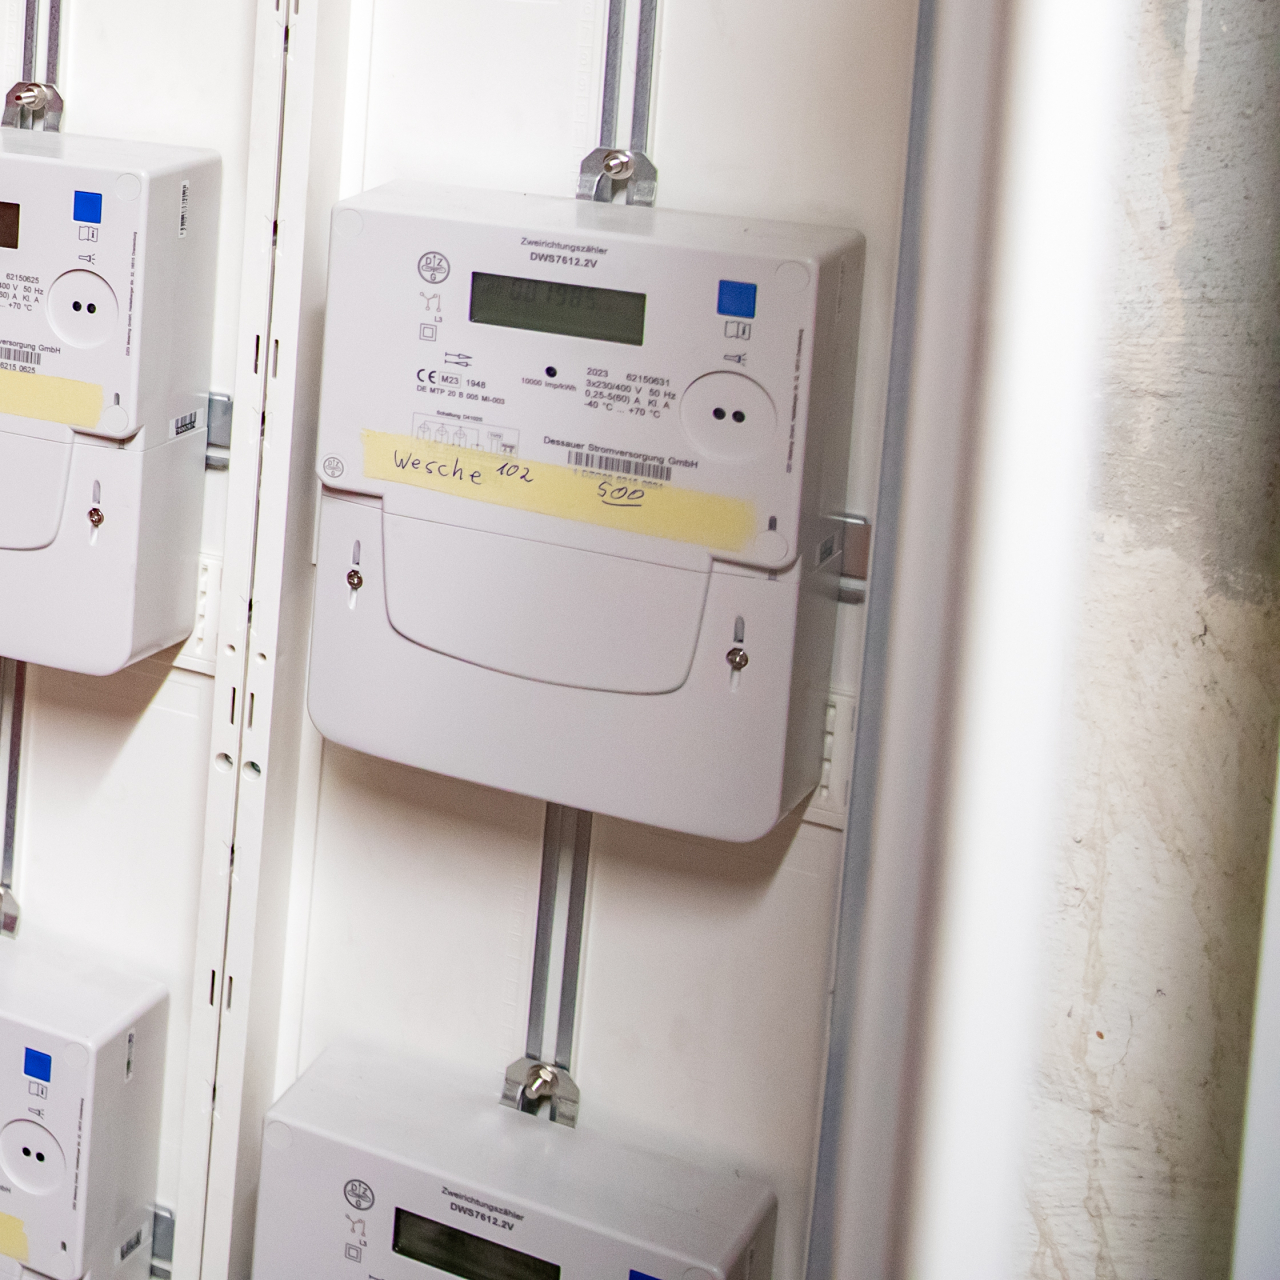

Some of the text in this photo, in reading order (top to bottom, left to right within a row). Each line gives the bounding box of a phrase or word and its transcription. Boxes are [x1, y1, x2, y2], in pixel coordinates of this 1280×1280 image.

[520, 237, 608, 256] Zweirichtungszähler
[530, 251, 598, 269] DWS7612.2V
[5, 273, 39, 284] 62150625
[23, 285, 32, 293] 50
[34, 287, 44, 295] Hz
[8, 302, 21, 310] +70
[38, 344, 61, 354] GmbH
[0, 361, 17, 371] 6215
[441, 375, 459, 385] M23
[466, 379, 486, 389] 1948
[522, 377, 542, 386] 10000
[586, 367, 670, 387] 2023 62150631
[416, 384, 427, 392] DE
[429, 386, 445, 395] MTP
[447, 389, 456, 397] 20
[466, 392, 479, 401] 005
[481, 395, 505, 405] MI-003
[585, 379, 676, 400] 3x230/400 V 50 Hz
[629, 407, 646, 416] +70
[663, 401, 670, 409] A
[543, 435, 698, 468] Dessauer Stromversorgung GmbH
[394, 449, 534, 485] Wesche 102
[597, 481, 645, 500] 500
[441, 1186, 525, 1222] Zweirichtungszähler
[449, 1202, 515, 1231] DWS7612.2V
